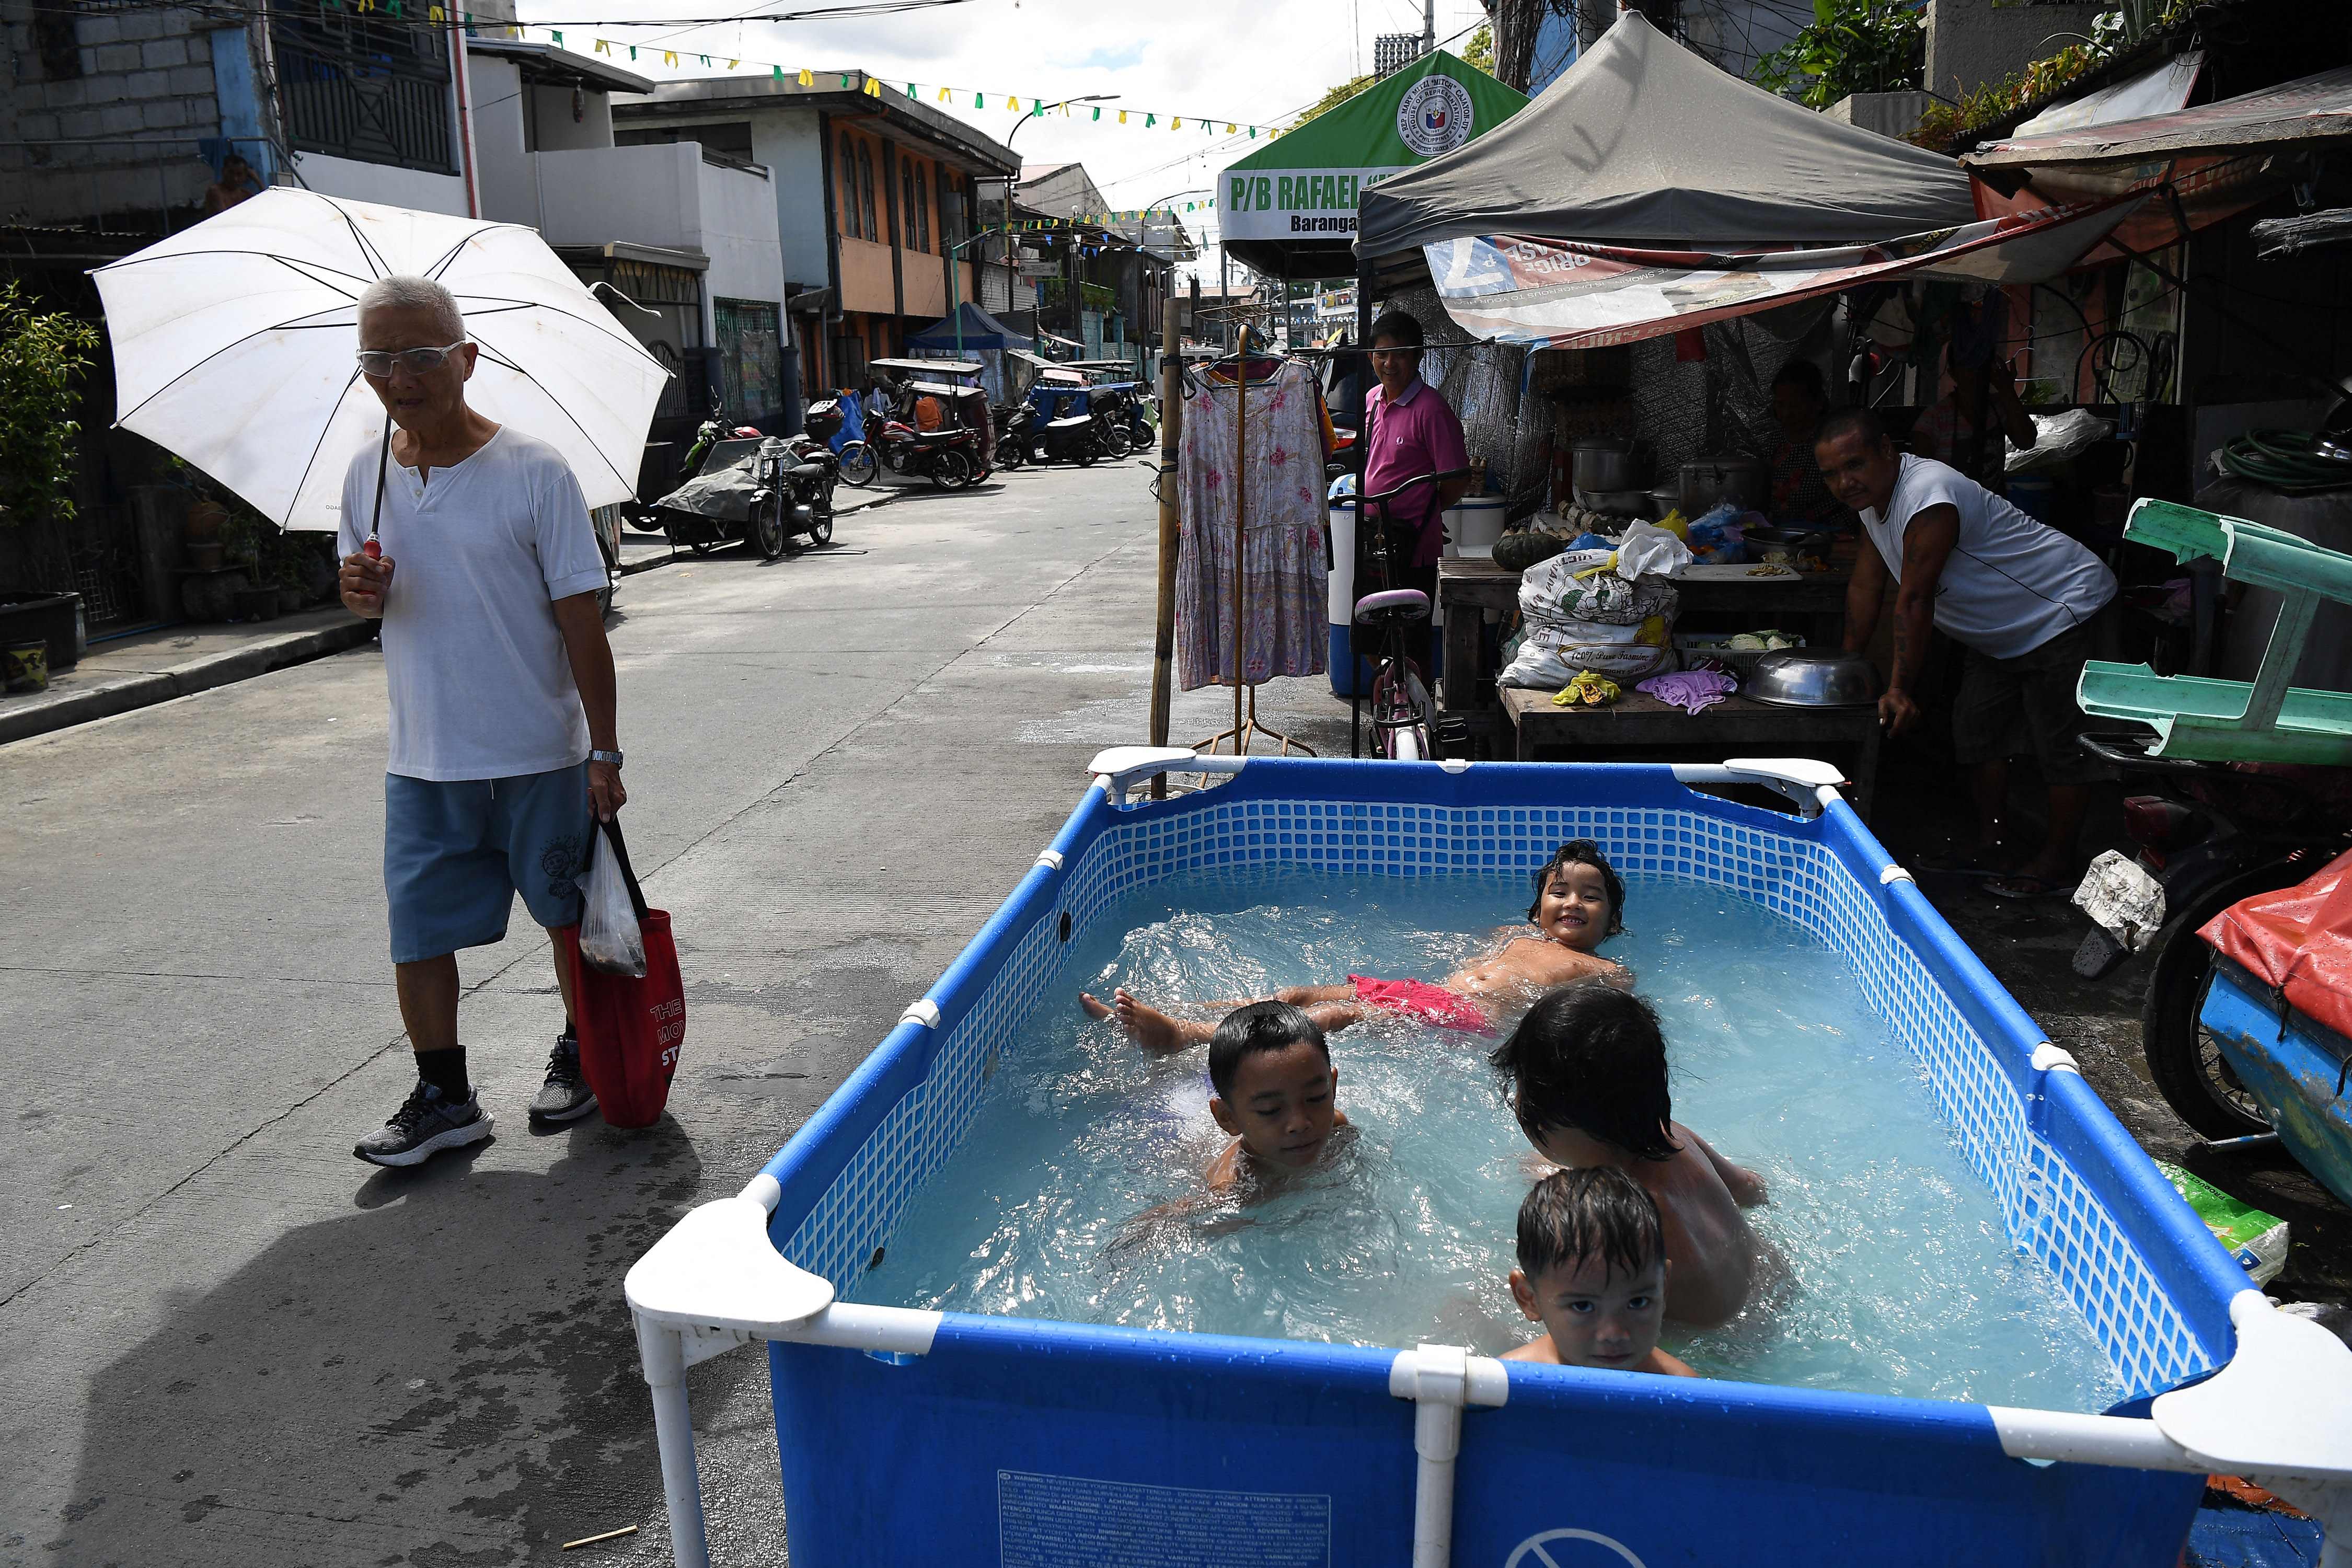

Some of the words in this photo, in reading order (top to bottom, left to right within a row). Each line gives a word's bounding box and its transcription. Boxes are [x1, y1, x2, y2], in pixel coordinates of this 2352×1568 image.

[1402, 95, 1413, 114] MARY
[1412, 80, 1429, 95] MITZI
[1416, 95, 1424, 103] OF
[1425, 89, 1459, 130] REPRESENTATIVES
[1419, 133, 1450, 143] PHILIPPINES
[1230, 176, 1272, 212] P/B
[1522, 251, 1591, 274] PRICE
[650, 998, 683, 1022] THE
[662, 1043, 682, 1066] ST
[2188, 1177, 2226, 1201] PRODUCT
